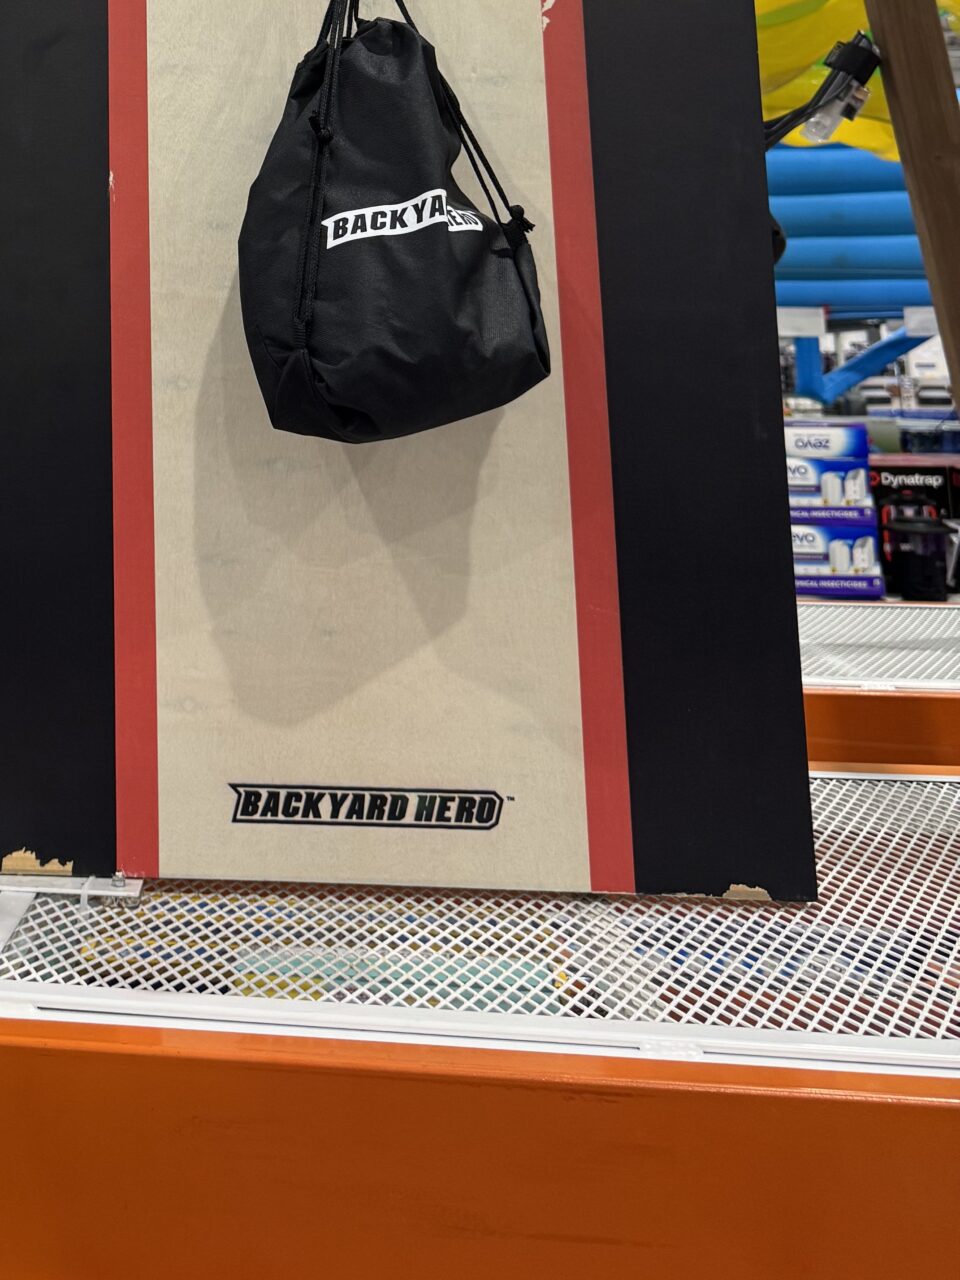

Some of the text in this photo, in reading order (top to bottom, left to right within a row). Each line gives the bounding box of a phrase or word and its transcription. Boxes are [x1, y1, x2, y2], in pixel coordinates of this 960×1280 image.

[332, 194, 445, 241] BACKYA
[880, 471, 944, 489] Dynatrap
[240, 789, 410, 821] BACKYARD
